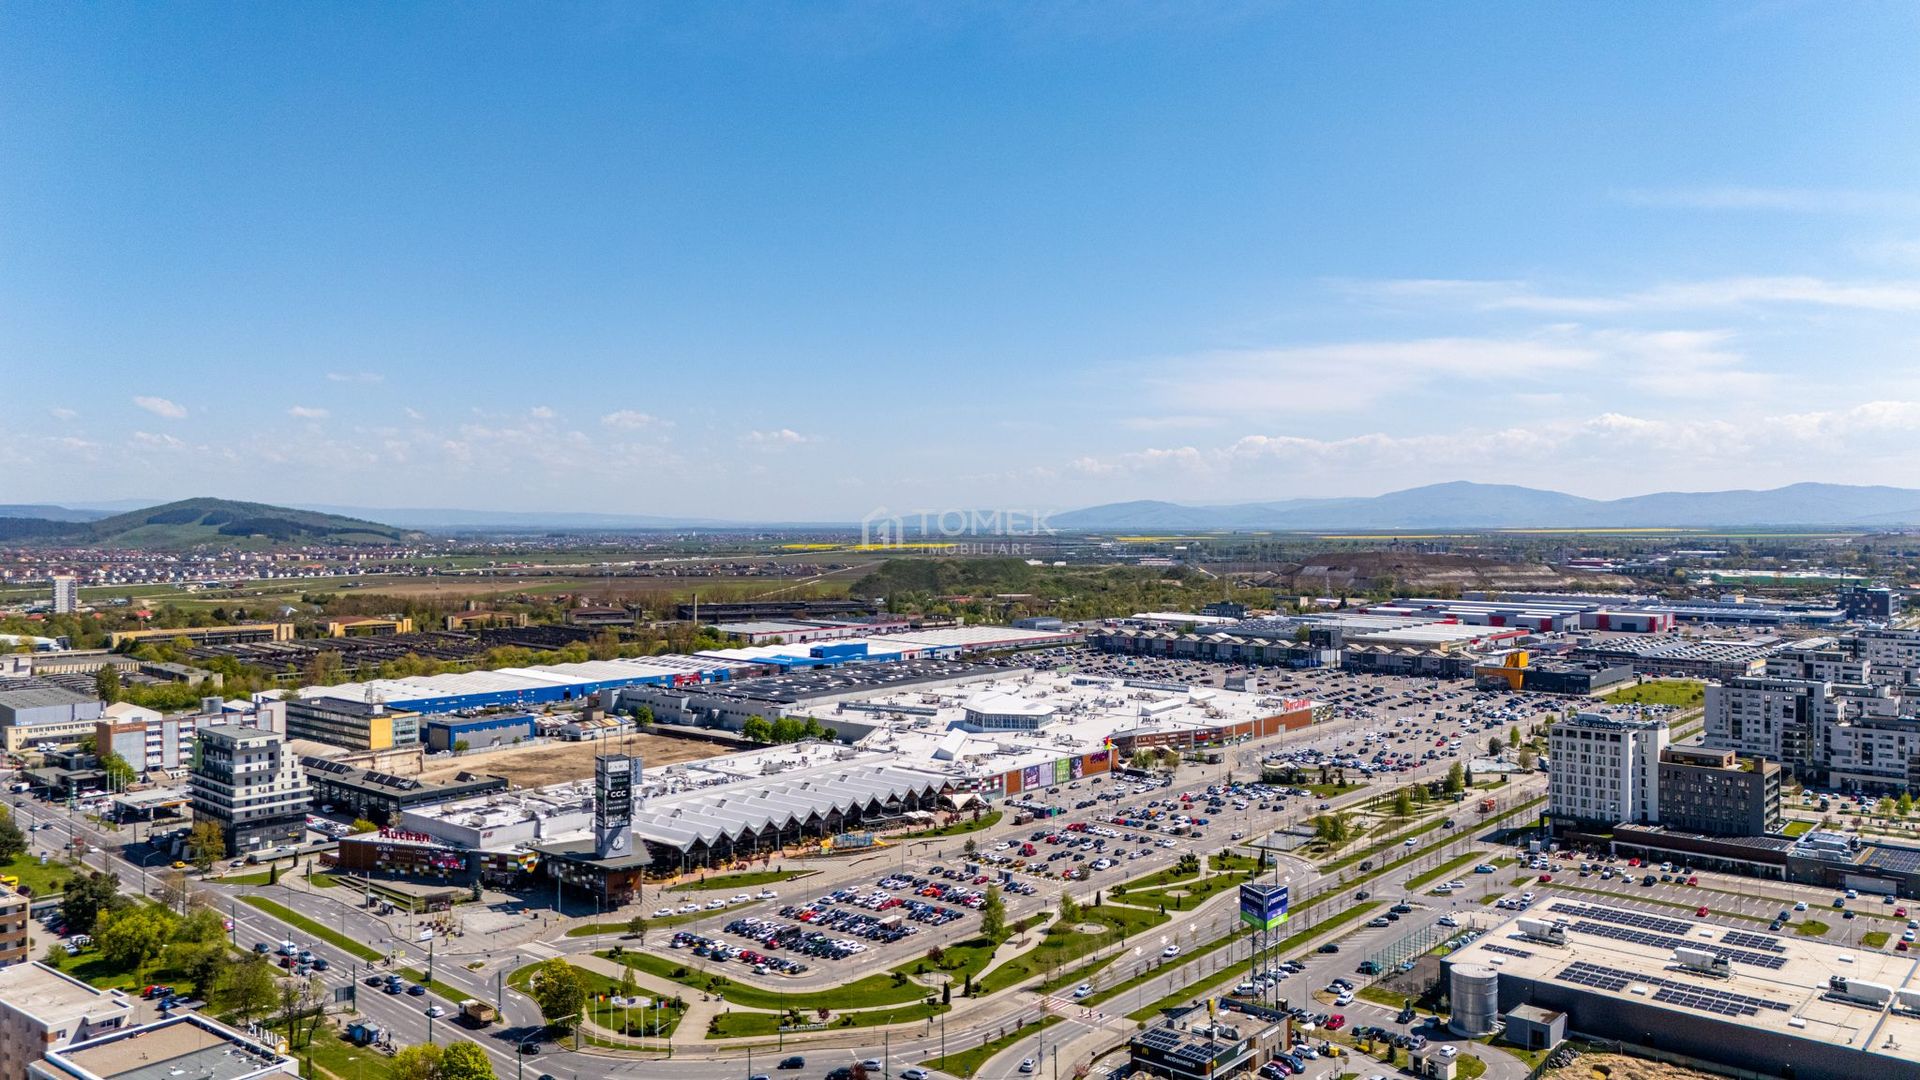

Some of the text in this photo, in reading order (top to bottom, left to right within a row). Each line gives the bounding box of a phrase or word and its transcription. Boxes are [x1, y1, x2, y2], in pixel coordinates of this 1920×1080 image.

[610, 790, 627, 798] CCC
[379, 825, 432, 842] Auchan
[1164, 1054, 1196, 1068] McDonald's
